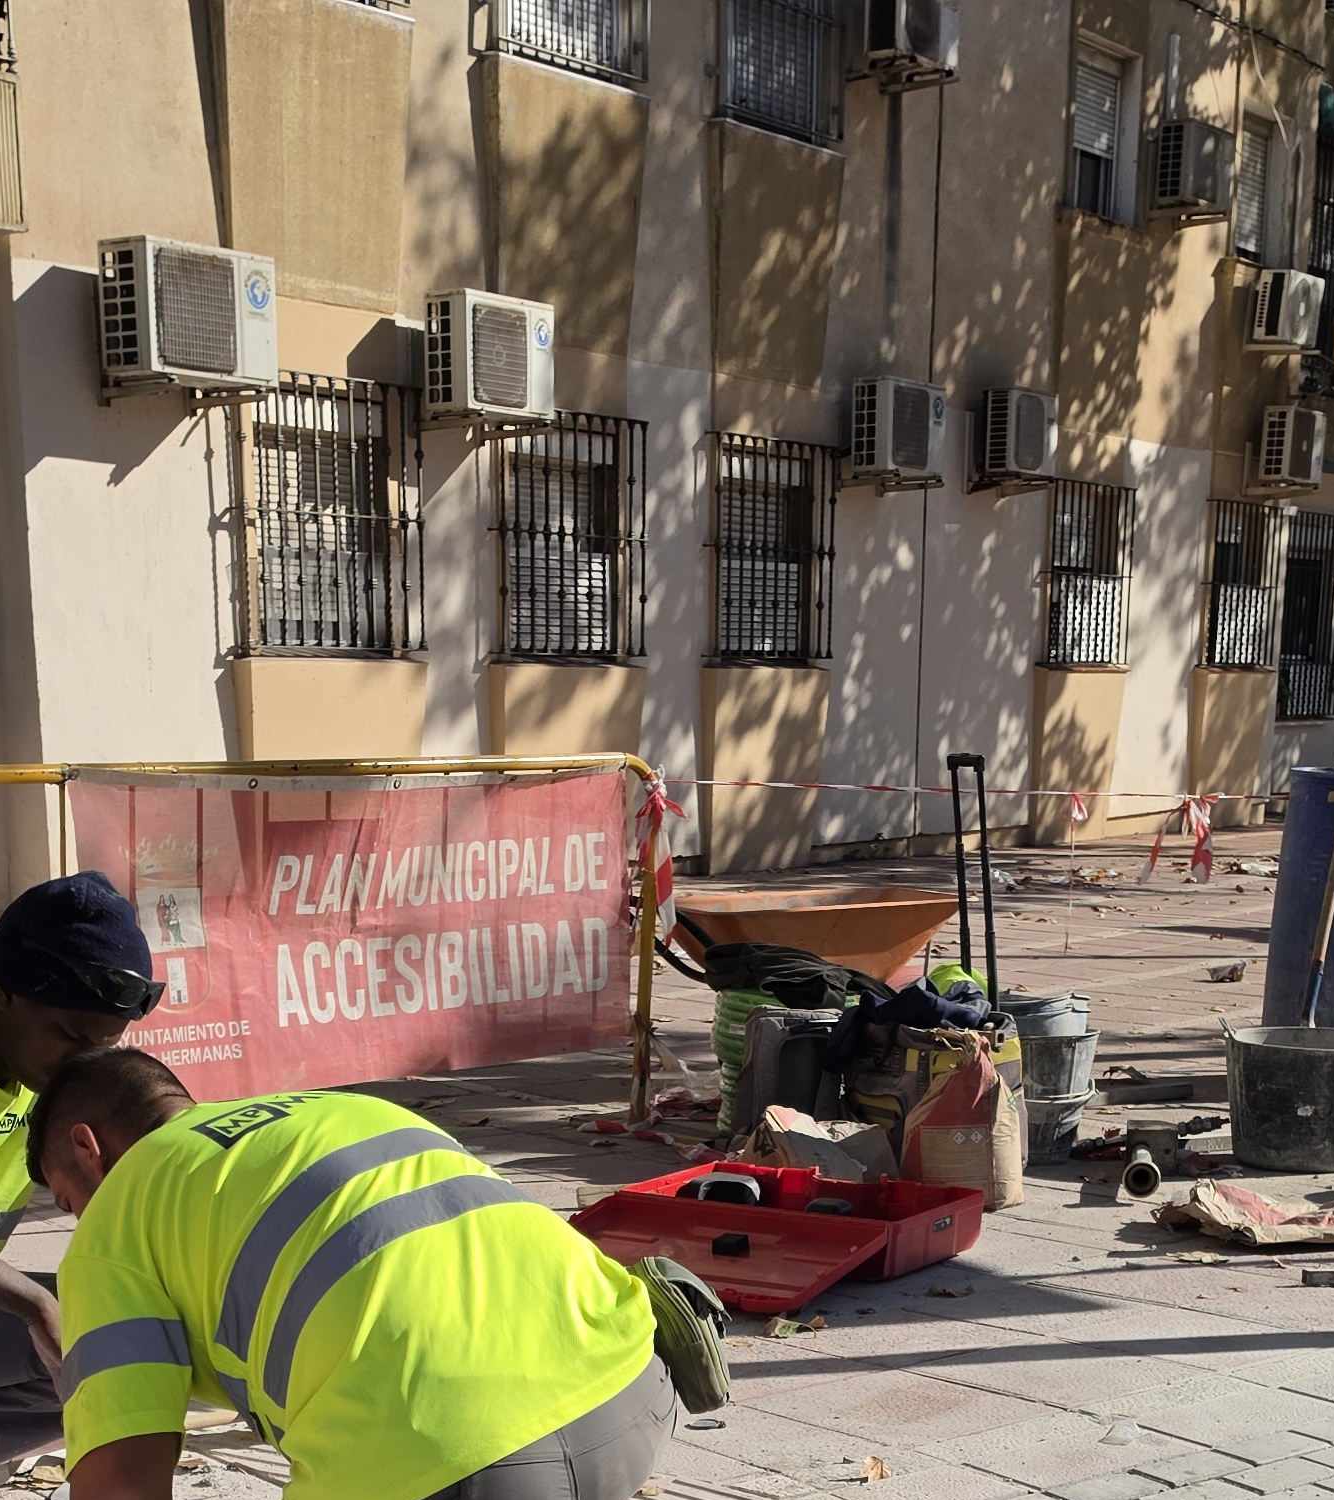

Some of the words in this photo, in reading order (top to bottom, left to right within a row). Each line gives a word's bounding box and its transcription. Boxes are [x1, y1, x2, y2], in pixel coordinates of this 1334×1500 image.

[269, 854, 377, 915] PLAN
[376, 837, 555, 909] MUNICIPAL
[564, 832, 608, 892] DE
[277, 917, 608, 1027] ACCESIBILIDAD
[229, 1020, 252, 1036] DE
[161, 1043, 243, 1067] HERMANAS
